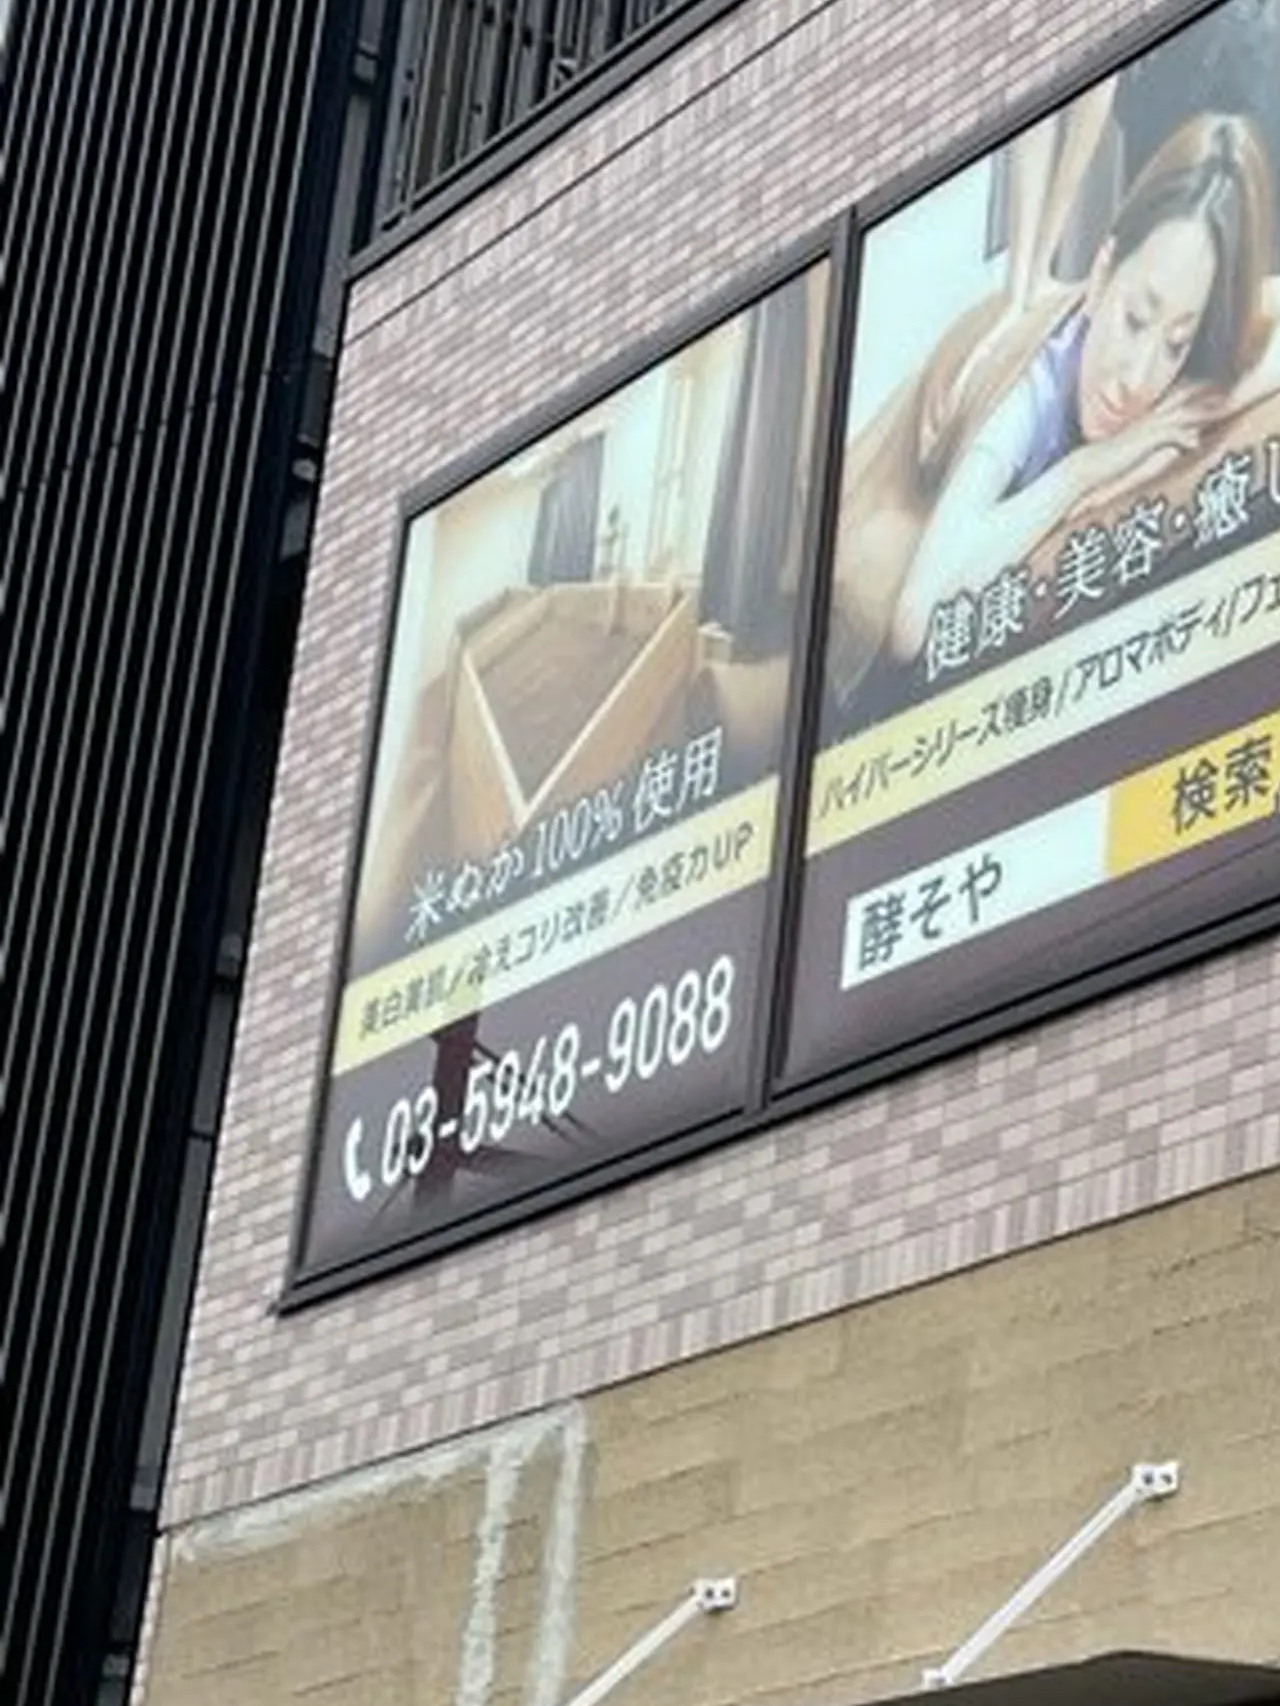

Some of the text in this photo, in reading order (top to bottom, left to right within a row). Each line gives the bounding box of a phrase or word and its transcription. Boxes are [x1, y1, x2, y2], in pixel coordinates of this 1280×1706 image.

[1171, 735, 1274, 836] 検索
[857, 852, 1003, 972] 酵そや
[380, 954, 735, 1186] 03-5948-9088
